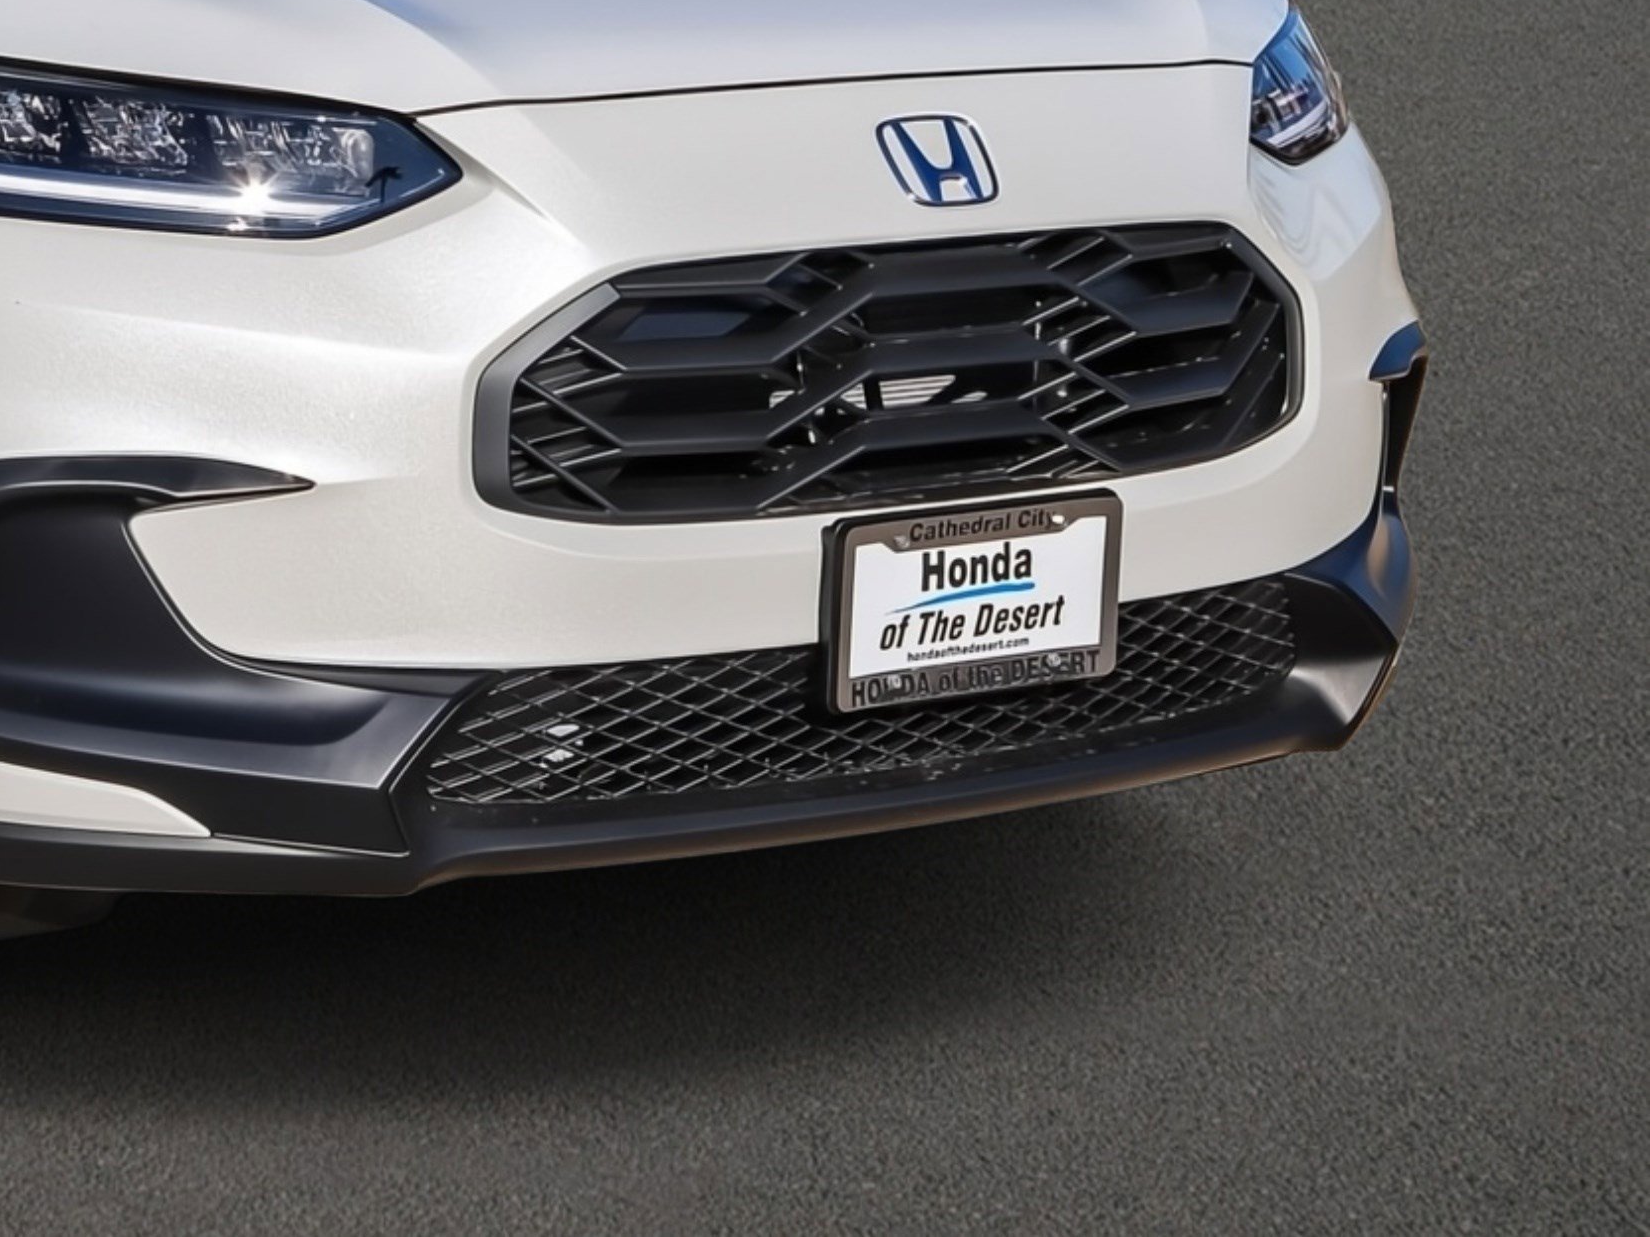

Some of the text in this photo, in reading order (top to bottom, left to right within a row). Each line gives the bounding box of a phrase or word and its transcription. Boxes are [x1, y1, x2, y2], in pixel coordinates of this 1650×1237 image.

[909, 512, 1011, 543] Cathedral
[921, 541, 1032, 591] Honda
[879, 595, 1066, 651] of The Desert
[939, 670, 959, 691] of
